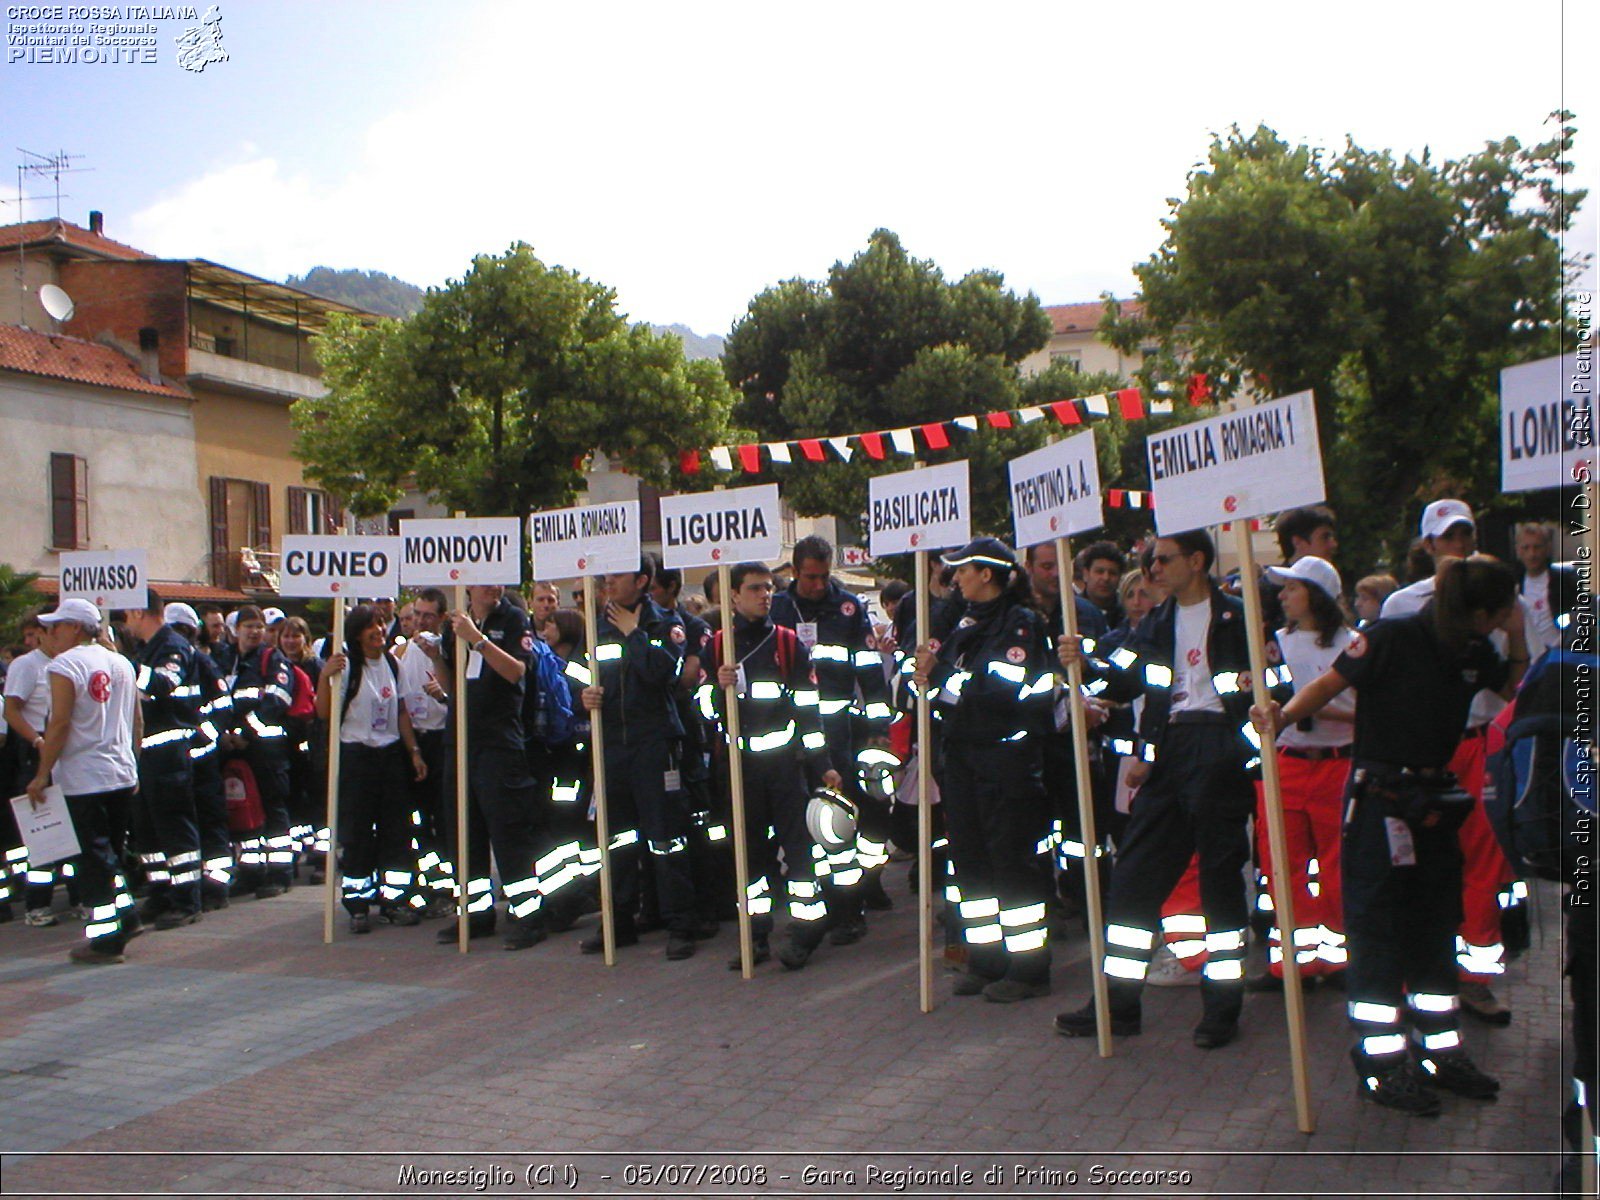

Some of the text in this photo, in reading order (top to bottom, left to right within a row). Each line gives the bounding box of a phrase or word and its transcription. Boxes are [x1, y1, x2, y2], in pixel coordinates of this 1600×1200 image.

[1151, 404, 1296, 481] EMILIA ROMAGNA 1
[1509, 394, 1600, 461] LOMBA
[1014, 459, 1091, 519] TRENTINO A. A.
[533, 507, 627, 544] EMILIA ROMAGNA 2
[666, 507, 768, 546] LIGURIA
[873, 486, 960, 532] BASILICATA
[286, 550, 388, 577] CUNEO
[405, 534, 508, 564] MONDOVI'
[62, 564, 137, 592] CHIVASSO
